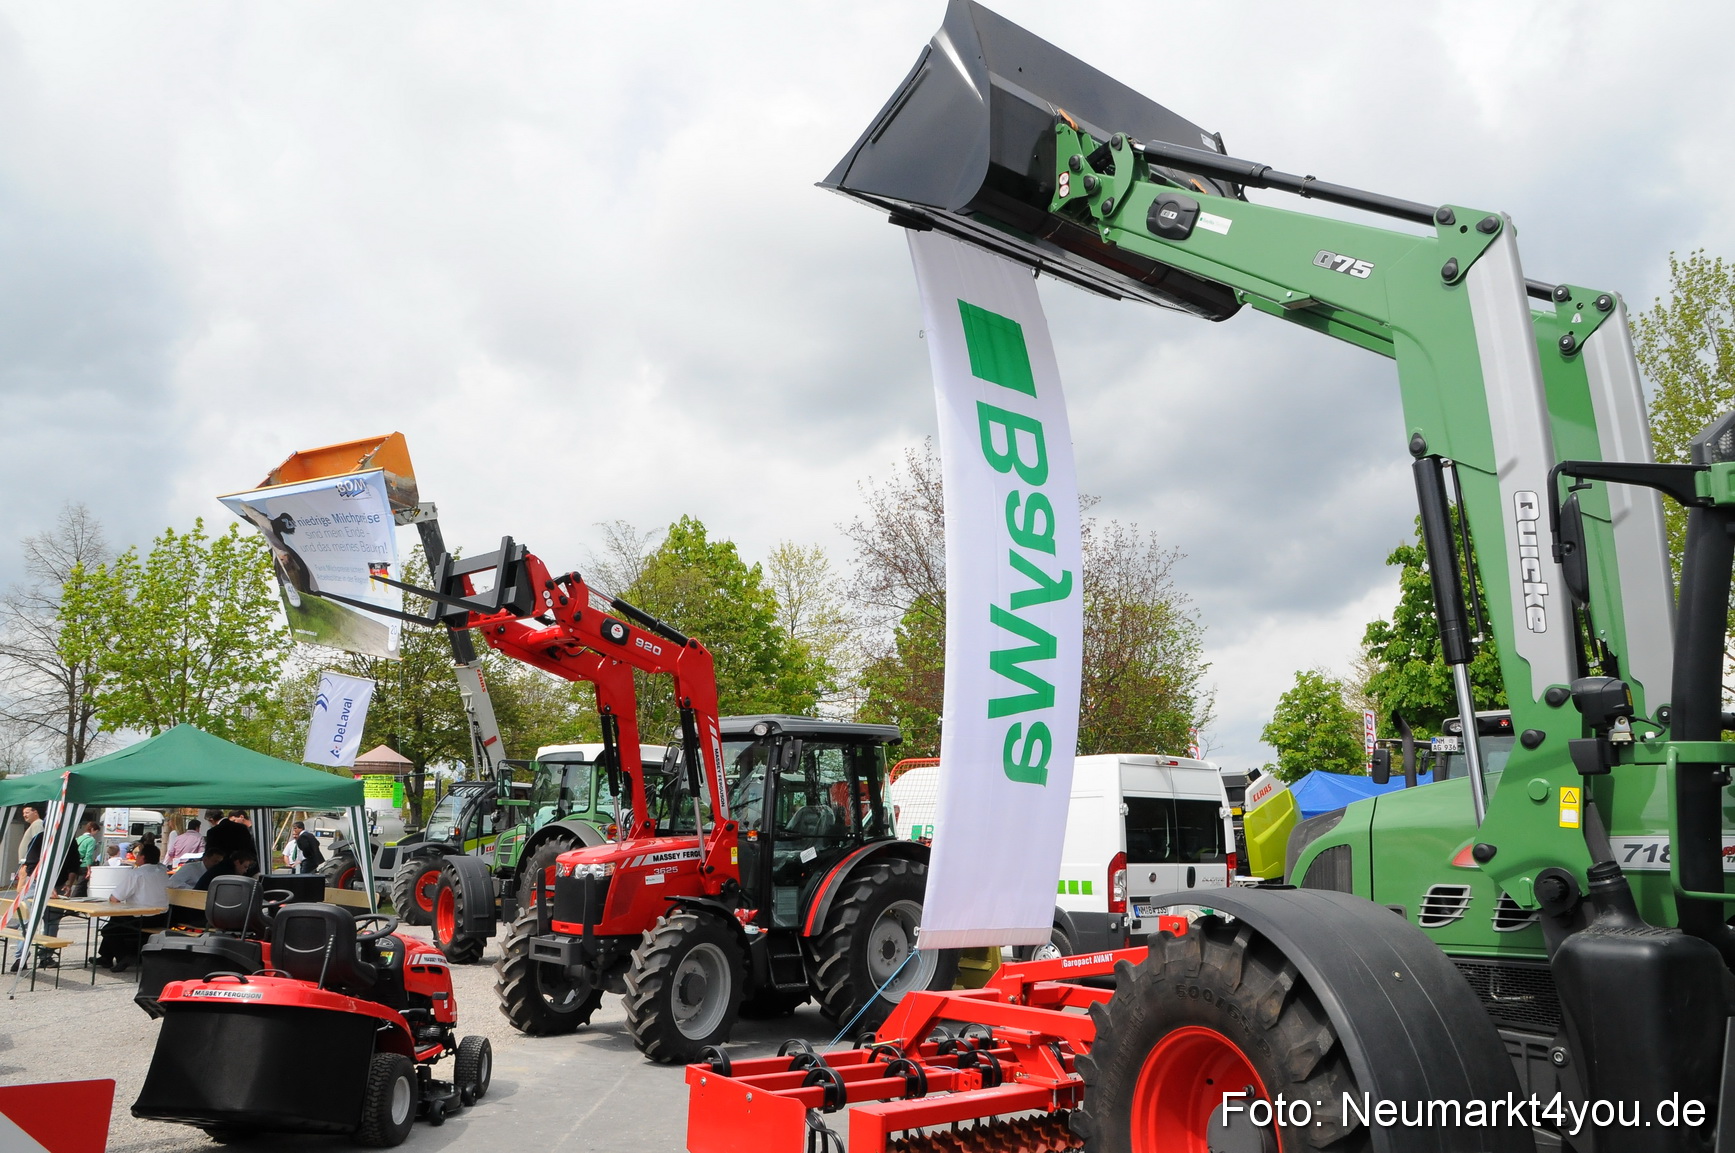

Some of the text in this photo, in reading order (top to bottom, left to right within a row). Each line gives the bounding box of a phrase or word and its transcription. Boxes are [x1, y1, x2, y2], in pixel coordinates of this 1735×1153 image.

[1312, 249, 1375, 279] Q75
[336, 478, 367, 493] BDM
[297, 515, 332, 528] niedrige
[304, 528, 323, 540] sind
[323, 527, 345, 539] mein
[344, 525, 365, 538] Ende
[299, 541, 317, 553] und
[316, 541, 332, 552] das
[331, 541, 360, 553] meines
[1513, 490, 1548, 633] Quicke
[635, 637, 662, 656] 920
[476, 669, 487, 692] CLAAS
[333, 697, 353, 743] DeLaval
[717, 774, 725, 808] FERGUSON
[1253, 783, 1272, 802] CLAAS
[652, 851, 681, 863] MASSEY
[654, 865, 679, 876] 3625
[1063, 952, 1113, 968] Garopact AVANT
[194, 989, 262, 999] MASSEY FERGUSON
